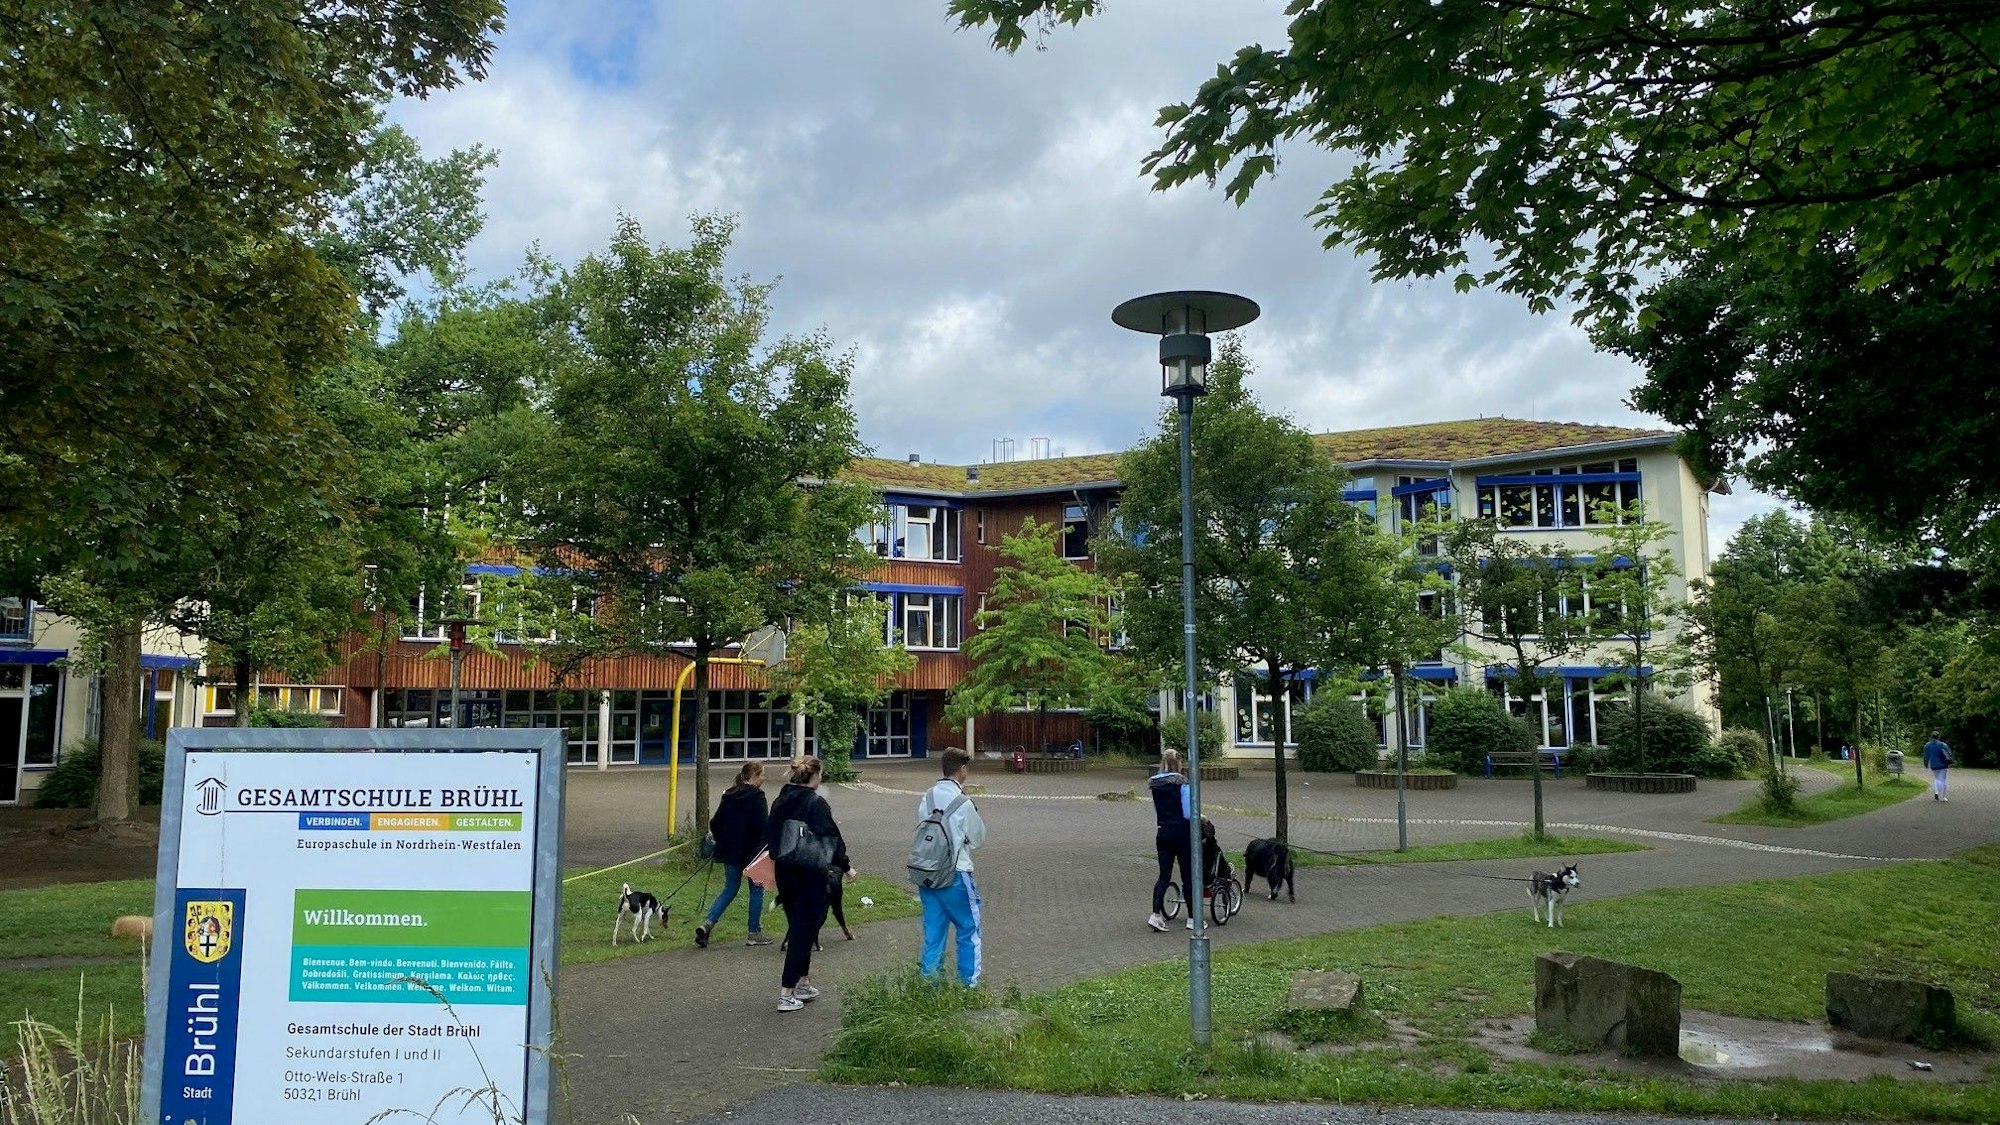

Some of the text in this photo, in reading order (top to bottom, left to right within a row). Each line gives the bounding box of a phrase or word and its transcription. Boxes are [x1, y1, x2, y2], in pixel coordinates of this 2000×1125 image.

[237, 785, 523, 807] GESAMTSCHULE BRÜHL
[305, 817, 363, 826] VERBINDEN.
[377, 817, 441, 827] ENGAGIEREN.
[455, 818, 514, 827] GESTALTEN.
[297, 839, 521, 851] Europaschule in Nordrhein-Westfalen
[303, 909, 428, 927] Willkommen.
[303, 957, 348, 967] Bienvenue.
[349, 958, 395, 967] Bem-vindo.
[396, 958, 440, 968] Benvenuti.
[441, 960, 489, 969] Bienvenido.
[302, 969, 349, 979] Dobrodošli.
[407, 982, 447, 992] Welme.
[449, 983, 484, 992] Welkom.
[487, 983, 516, 993] Witam.
[185, 983, 220, 1075] Brühl
[287, 1022, 481, 1038] Gesamtschule der Stadt Brühl
[286, 1046, 442, 1061] Sekundarstufen I und II
[284, 1070, 404, 1084] Otto-Wels-Straße 1
[182, 1086, 213, 1099] Stadt
[283, 1088, 361, 1102] 50321 Brühl
